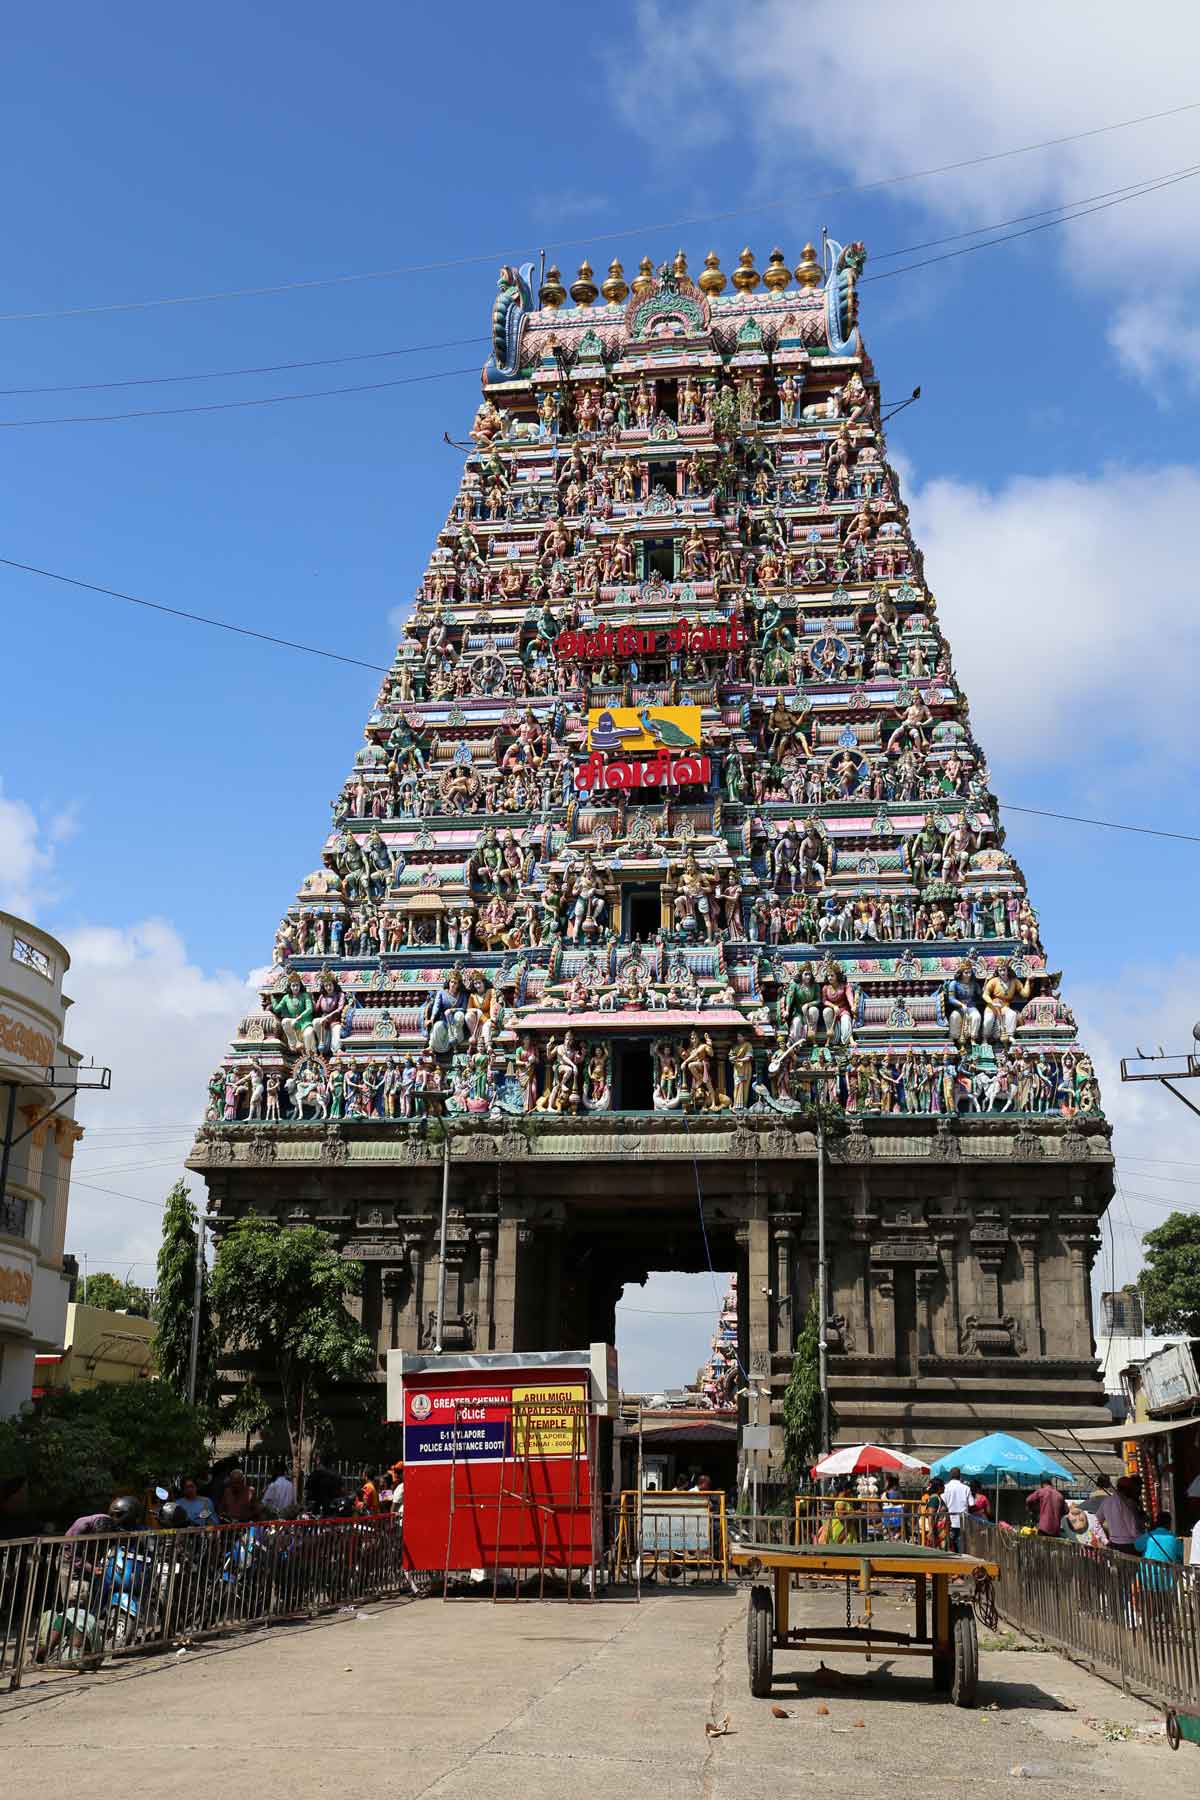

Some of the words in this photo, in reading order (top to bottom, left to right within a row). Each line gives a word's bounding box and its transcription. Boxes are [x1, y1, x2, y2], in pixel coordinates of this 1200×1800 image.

[552, 623, 657, 660] அன்பே
[667, 614, 748, 653] சிவம்
[456, 1408, 486, 1420] POLICE
[530, 1418, 567, 1430] TEMPLE
[419, 1443, 442, 1453] POLICE
[443, 1442, 483, 1452] ASSISTANCE
